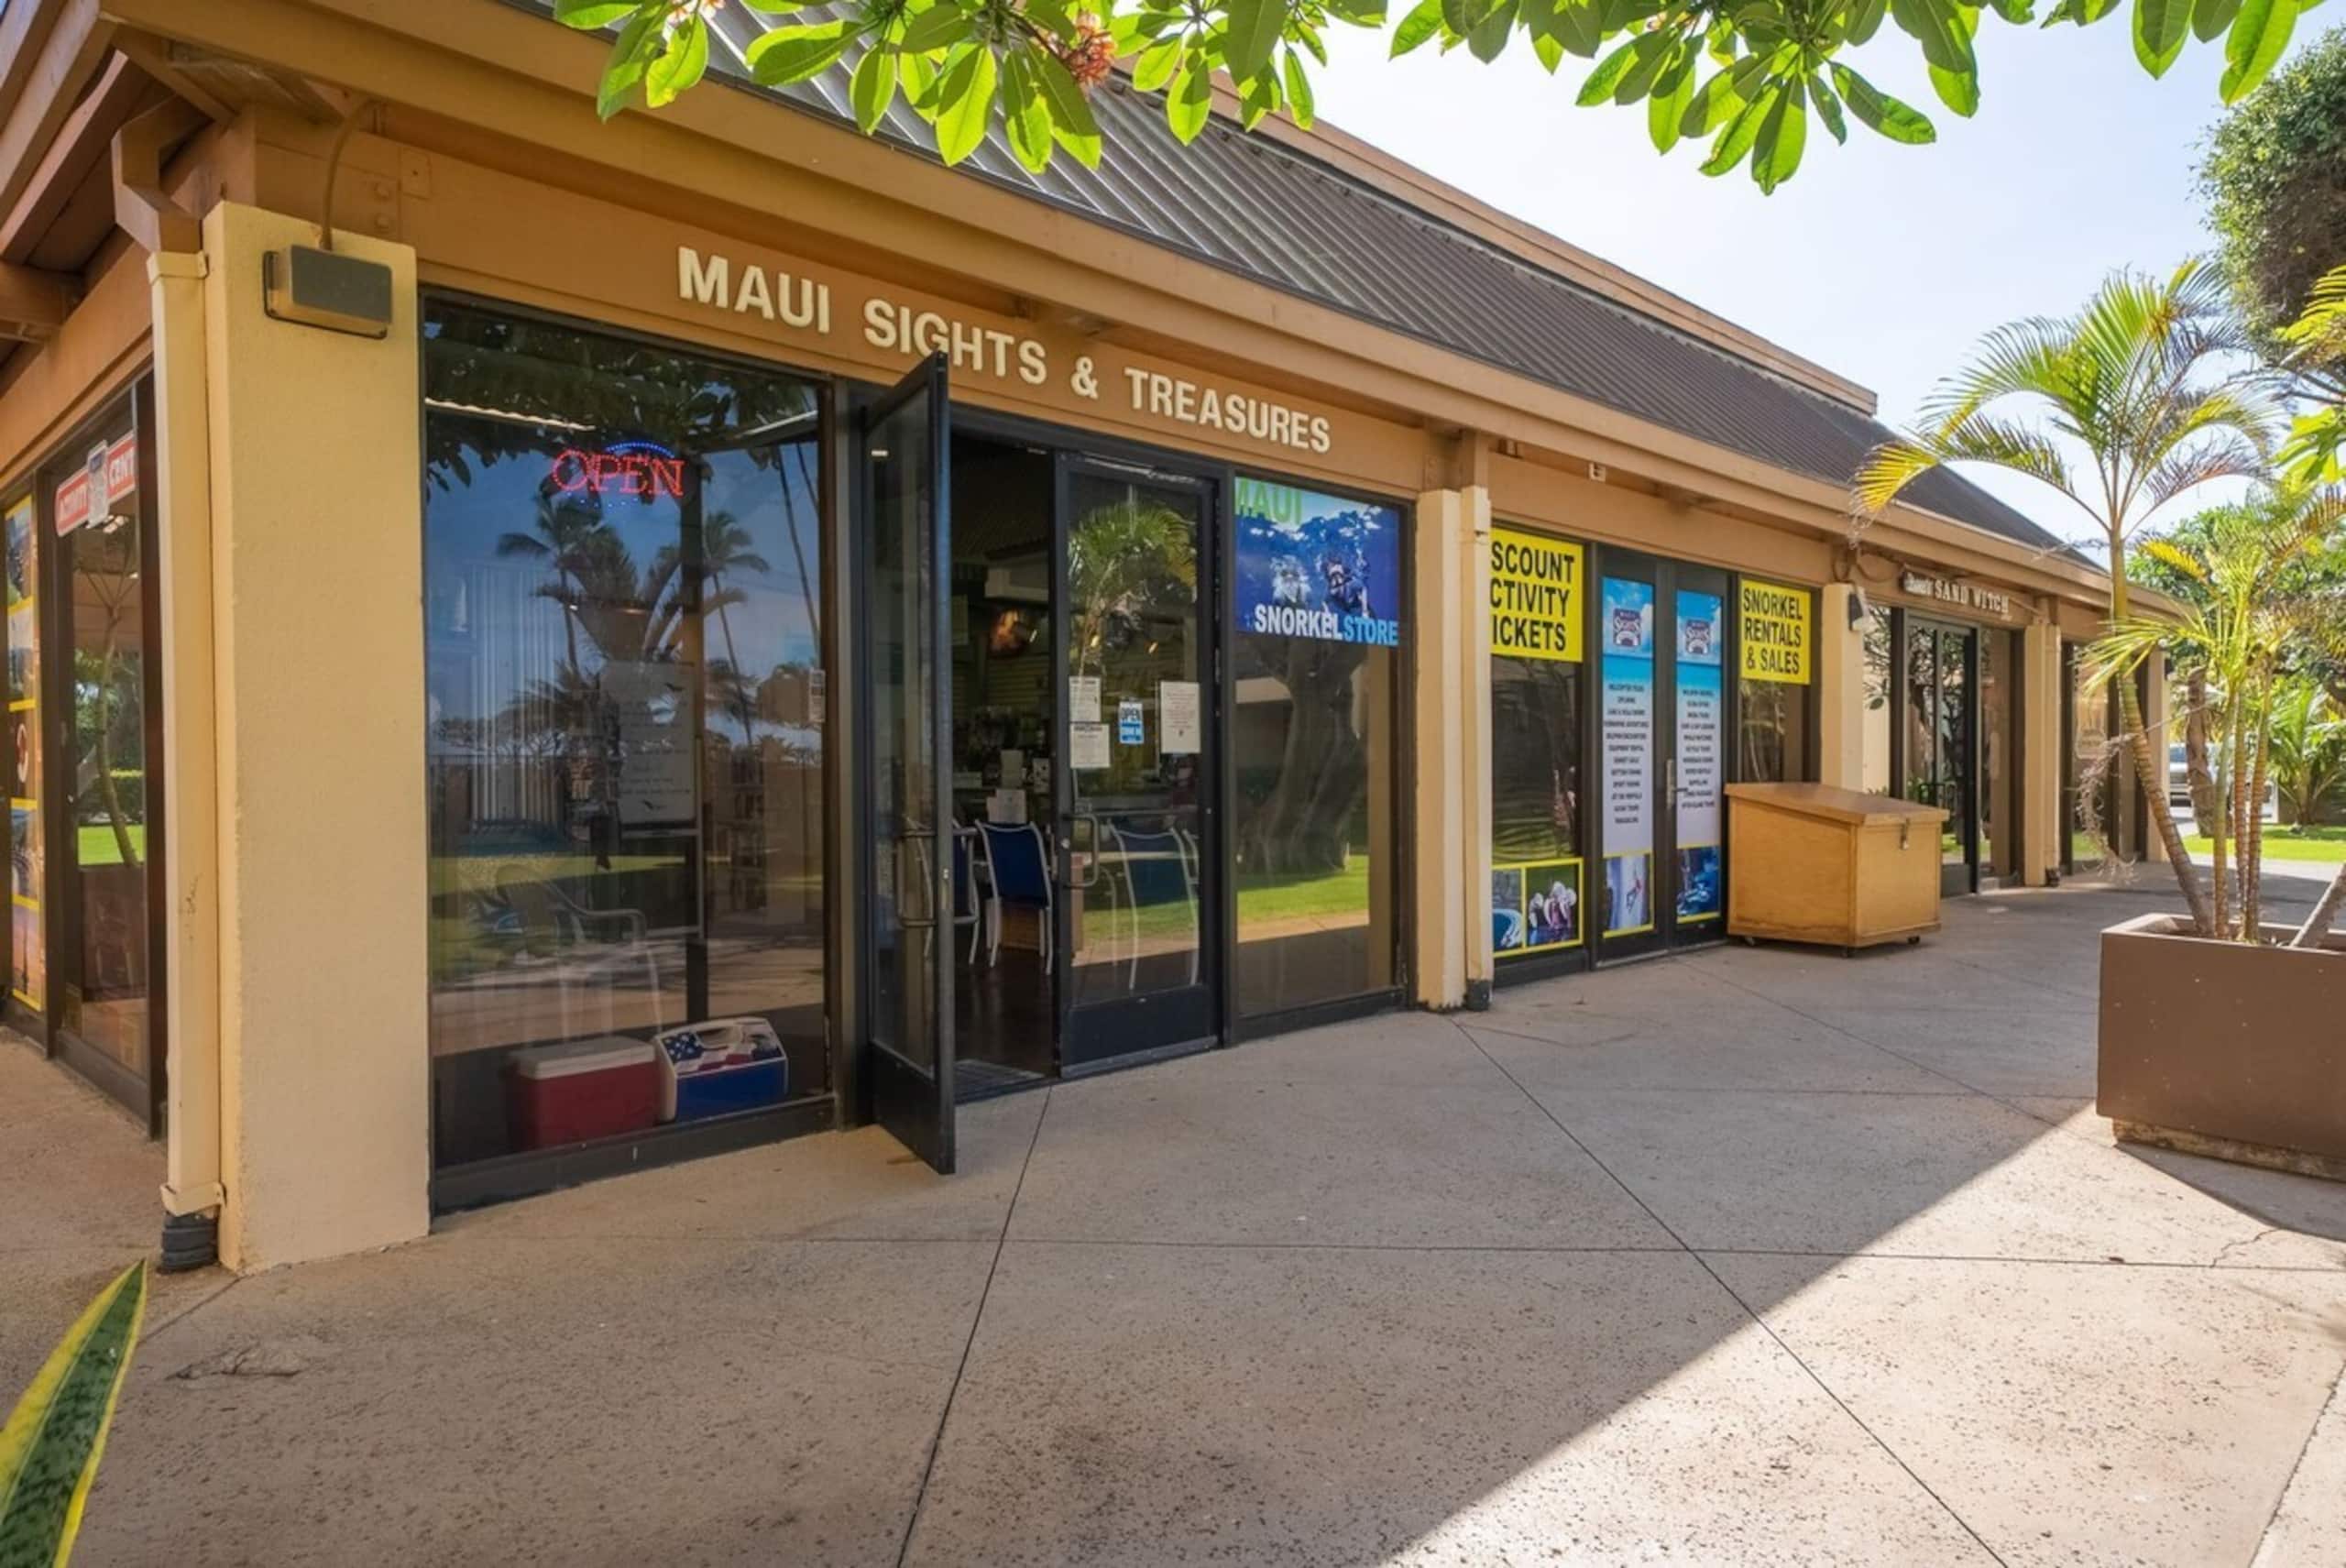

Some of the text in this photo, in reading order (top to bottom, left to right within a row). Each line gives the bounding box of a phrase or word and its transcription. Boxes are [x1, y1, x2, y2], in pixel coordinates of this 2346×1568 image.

[678, 246, 1332, 455] MAUI SIGHTS & TREASURES
[552, 447, 685, 498] OPEN
[1491, 540, 1575, 584] SCOUNT
[1489, 576, 1571, 619] CTIVITY
[1743, 587, 1803, 620] SNORKEL
[1492, 613, 1566, 652] ICKETS
[1744, 617, 1803, 648] RENTALS
[1746, 645, 1801, 675] & SALES
